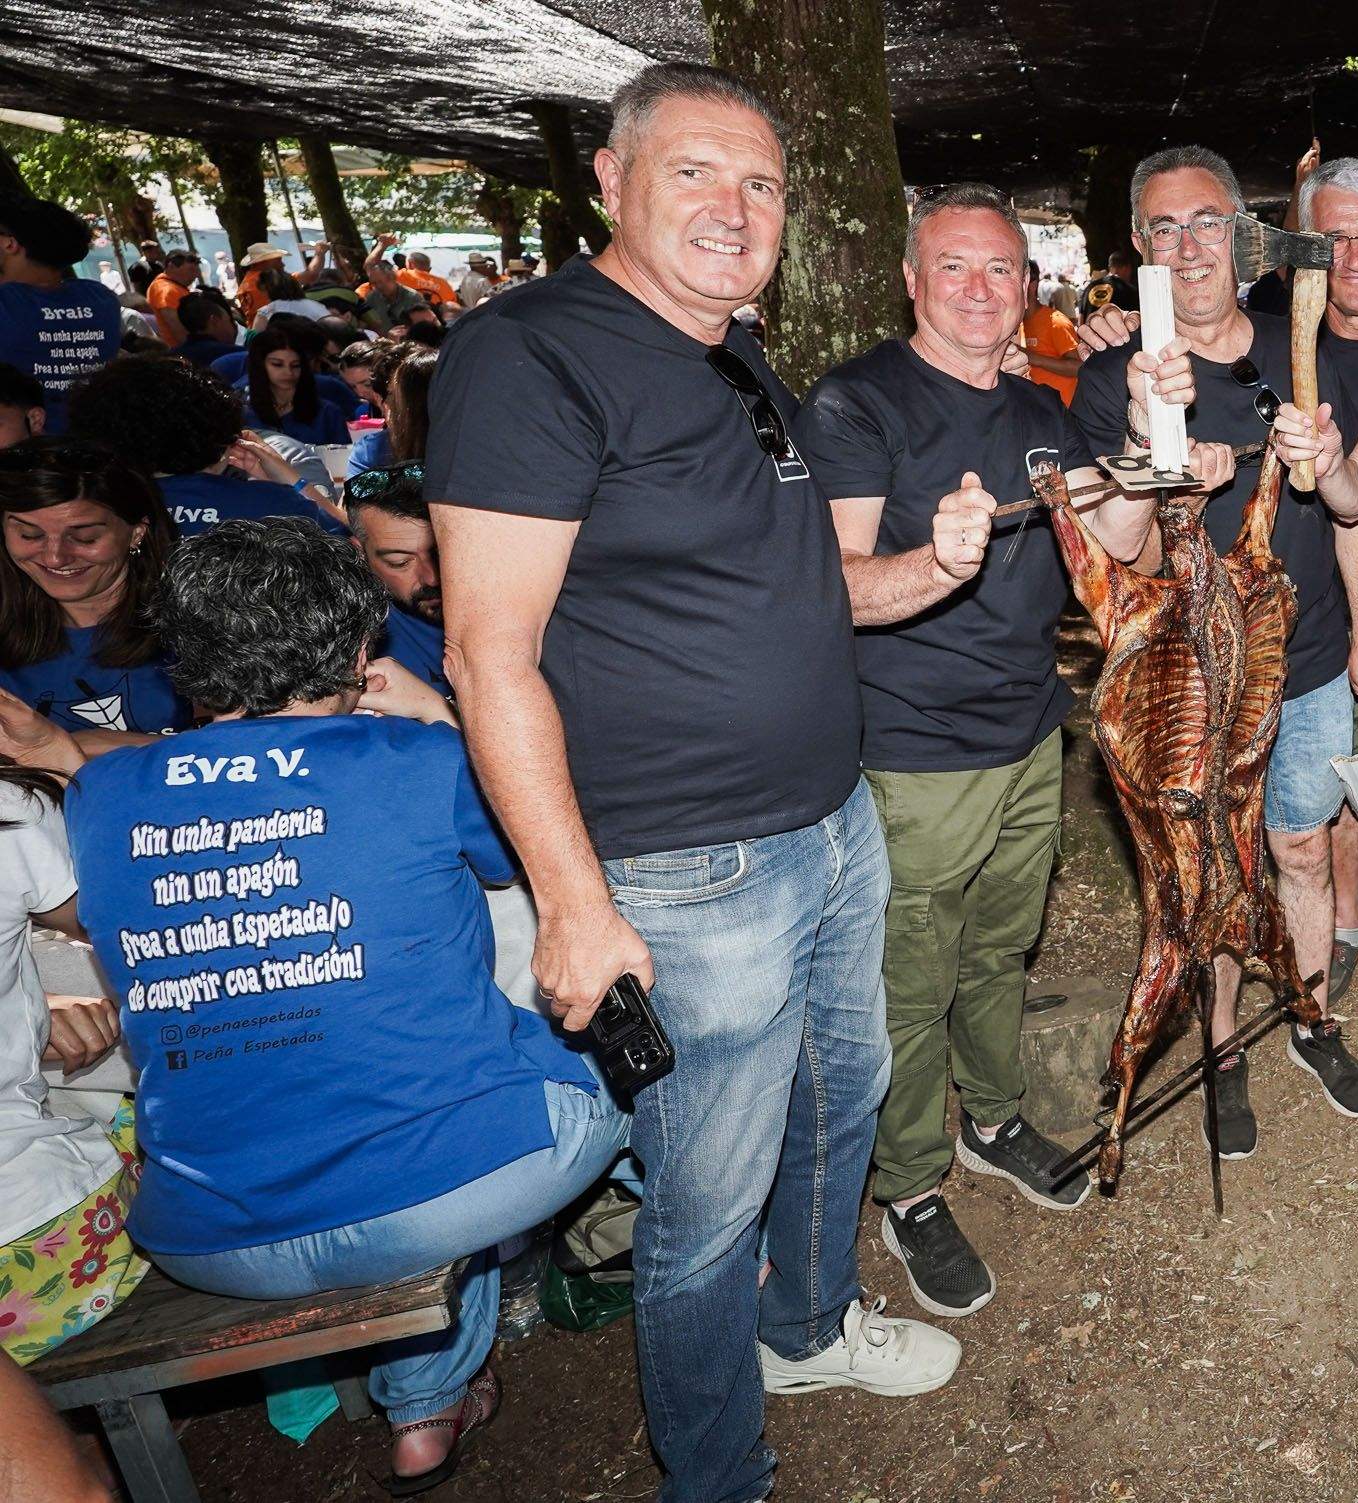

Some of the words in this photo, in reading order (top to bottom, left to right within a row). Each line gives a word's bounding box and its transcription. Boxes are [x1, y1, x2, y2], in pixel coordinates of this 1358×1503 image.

[41, 307, 93, 320] Brais
[165, 753, 257, 786] Eva
[266, 748, 310, 778] V.
[131, 823, 170, 859] Nin
[171, 816, 226, 856] unha
[227, 806, 328, 853] pandemia
[153, 871, 192, 905] nin
[193, 868, 223, 900] un
[225, 850, 301, 899] apagón
[119, 929, 166, 968] frea
[164, 926, 180, 957] a
[180, 913, 231, 953] unha
[232, 893, 353, 949] Espetada/o
[127, 979, 146, 1013] de
[147, 969, 222, 1013] cumprir
[224, 965, 263, 998] coa
[261, 942, 365, 992] tradición!
[192, 1046, 233, 1063] Peña
[244, 1031, 325, 1053] Espetados
